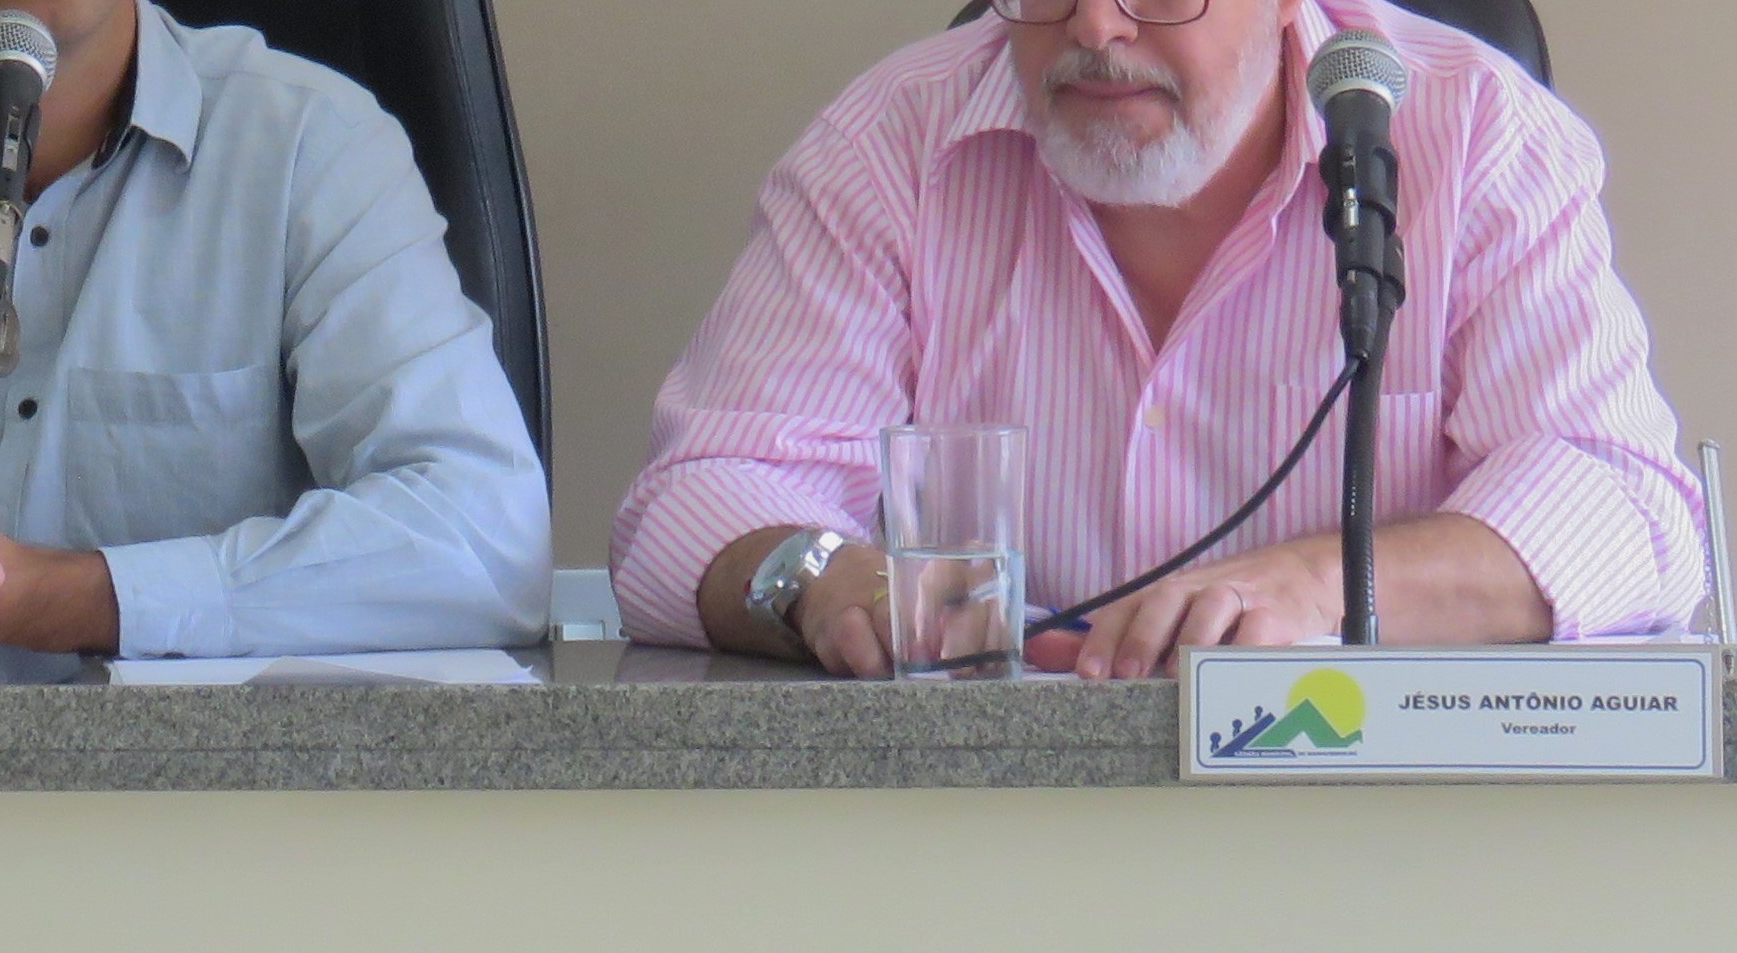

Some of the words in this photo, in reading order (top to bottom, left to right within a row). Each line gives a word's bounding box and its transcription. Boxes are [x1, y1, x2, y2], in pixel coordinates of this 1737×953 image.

[1398, 691, 1471, 710] JÉSUS
[1479, 693, 1583, 710] ANTÔNIO
[1590, 696, 1678, 711] AGUIAR
[1502, 722, 1576, 735] Vereador
